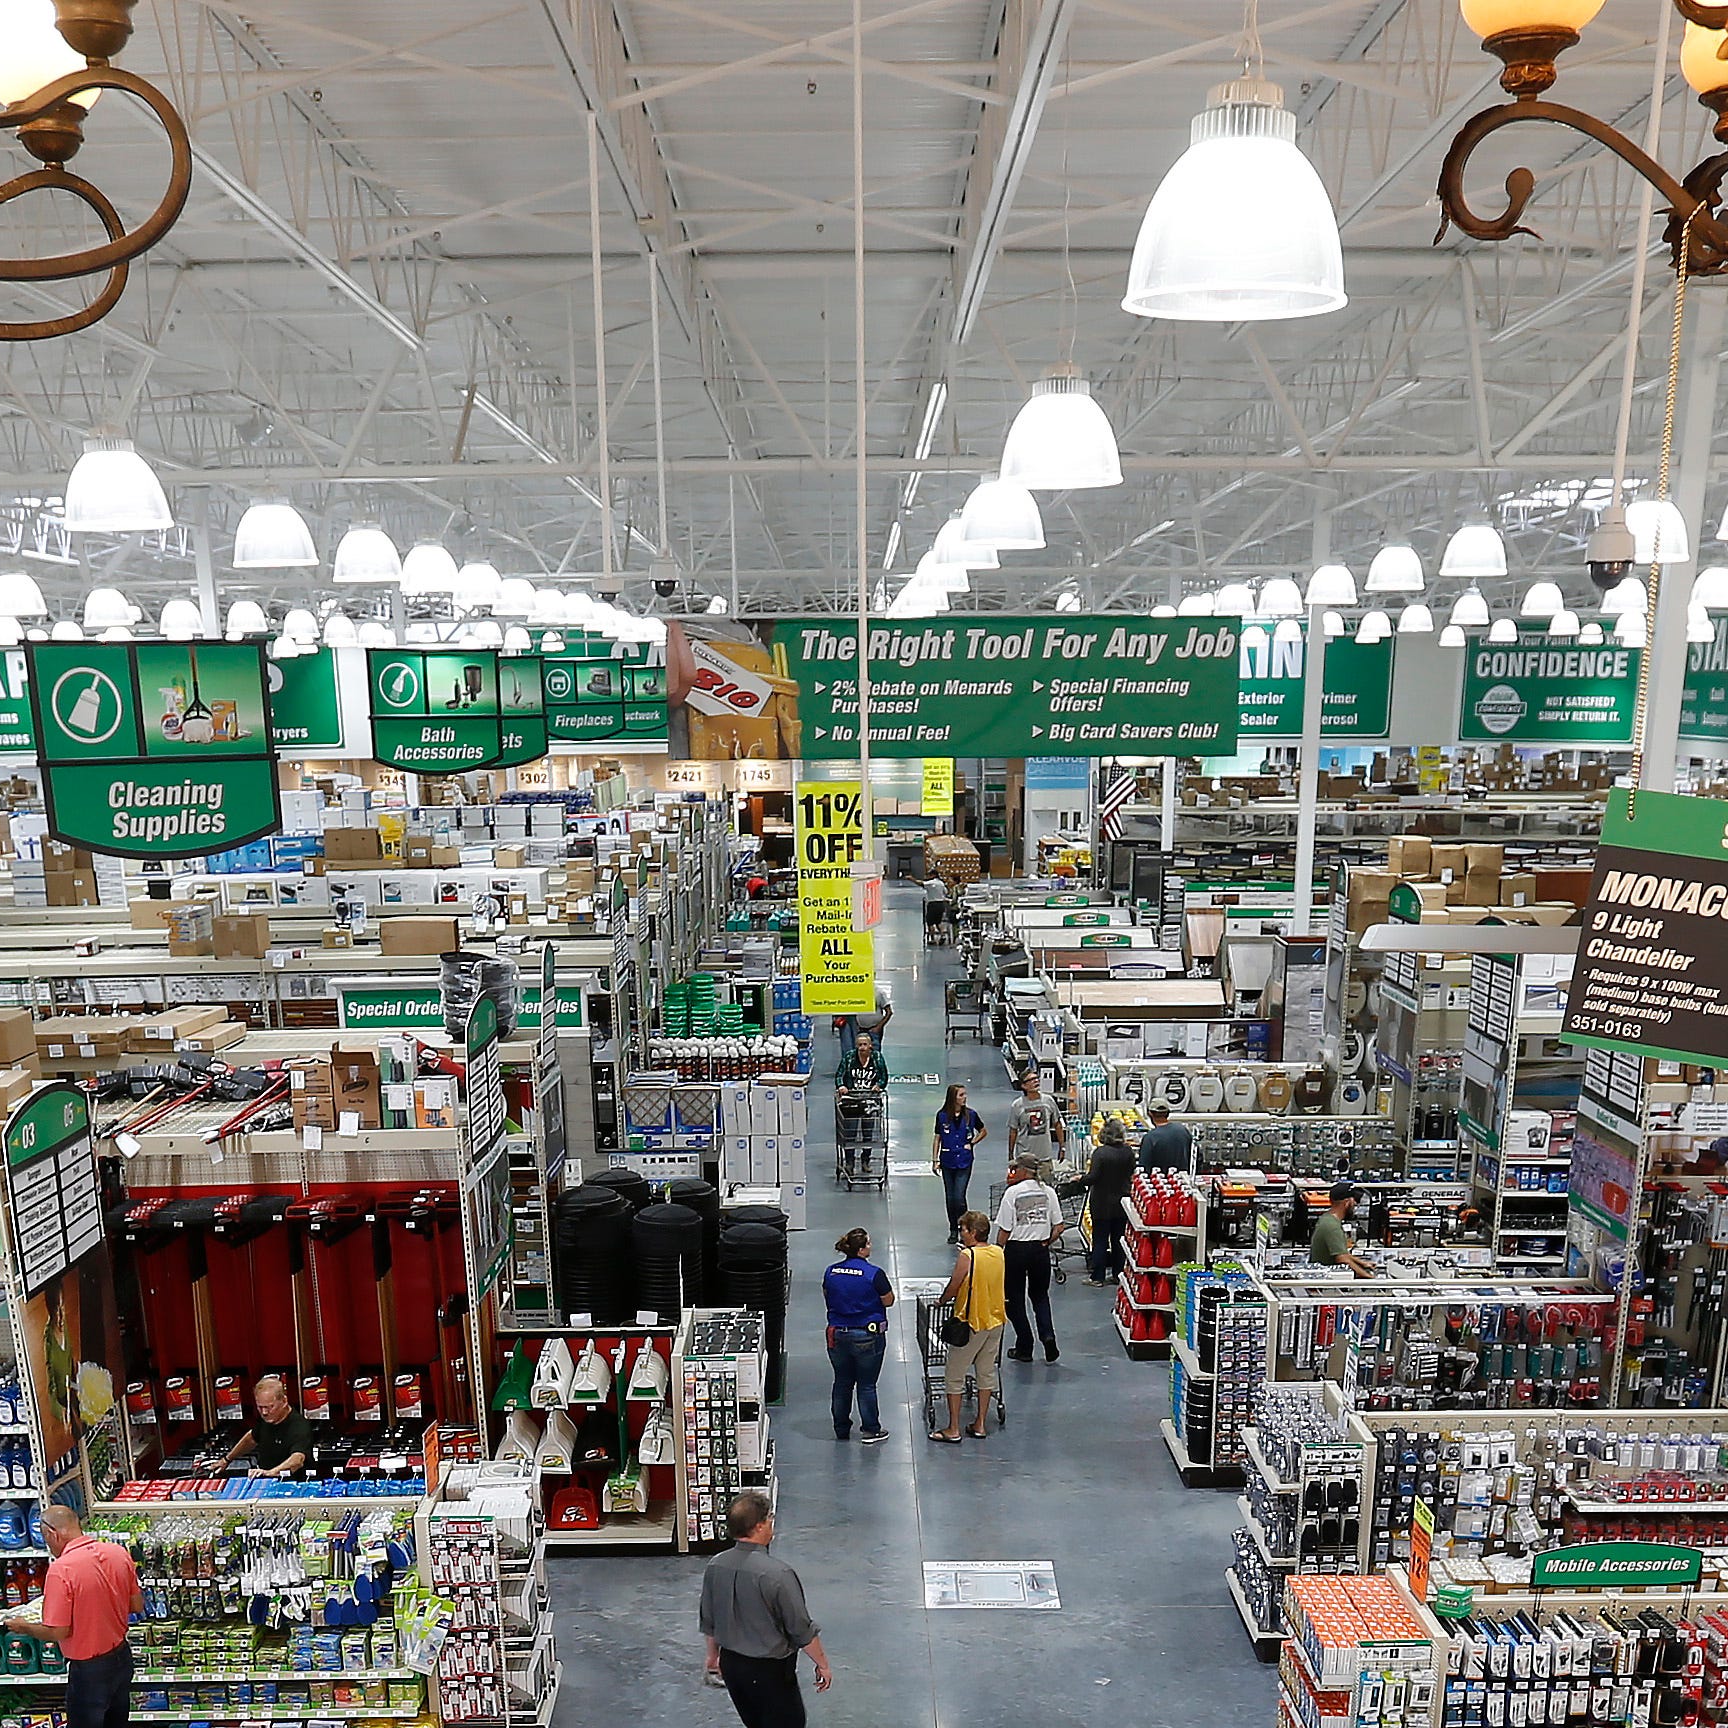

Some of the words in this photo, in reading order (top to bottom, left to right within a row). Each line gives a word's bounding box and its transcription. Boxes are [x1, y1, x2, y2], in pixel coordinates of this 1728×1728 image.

[801, 629, 858, 661] The
[866, 628, 956, 667] Right
[966, 628, 1032, 660] Tool
[1042, 628, 1098, 659] For
[1106, 627, 1166, 666] Any
[1176, 626, 1236, 660] Job
[1476, 651, 1629, 679] CONFIDENCE
[944, 679, 1012, 695] Menards
[1050, 678, 1109, 698] Special
[1113, 678, 1190, 697] Financing
[1050, 695, 1103, 712] Offers!
[1238, 692, 1285, 705] Exterior
[555, 713, 614, 729] Fireplaces
[1241, 713, 1279, 726] Sealer
[421, 727, 455, 742] Bath
[832, 726, 853, 740] No
[916, 725, 950, 740] Fee!
[1049, 724, 1075, 742] Big
[1080, 723, 1115, 739] Card
[1121, 723, 1173, 739] Savers
[1178, 723, 1219, 739] Club!
[393, 744, 484, 760] Accessories
[107, 781, 223, 813] Cleaning
[112, 810, 226, 840] Supplies
[1592, 912, 1608, 931] 9
[1609, 915, 1664, 941] Light
[821, 940, 852, 957] ALL
[1586, 939, 1695, 973] Chandelier
[824, 961, 850, 970] Your
[1587, 969, 1639, 991] Requires
[1661, 980, 1694, 996] 100W
[1694, 986, 1720, 998] max
[1586, 983, 1640, 1005] (medium)
[1642, 991, 1668, 1007] base
[1670, 995, 1702, 1012] bulbs
[1582, 999, 1608, 1012] sold
[1608, 1001, 1672, 1026] separately)
[1571, 1014, 1642, 1039] 351-0163
[22, 1122, 35, 1149] 03
[1422, 1190, 1466, 1198] GENERAC
[1544, 1559, 1596, 1572] Mobile
[1600, 1558, 1690, 1572] Accessories
